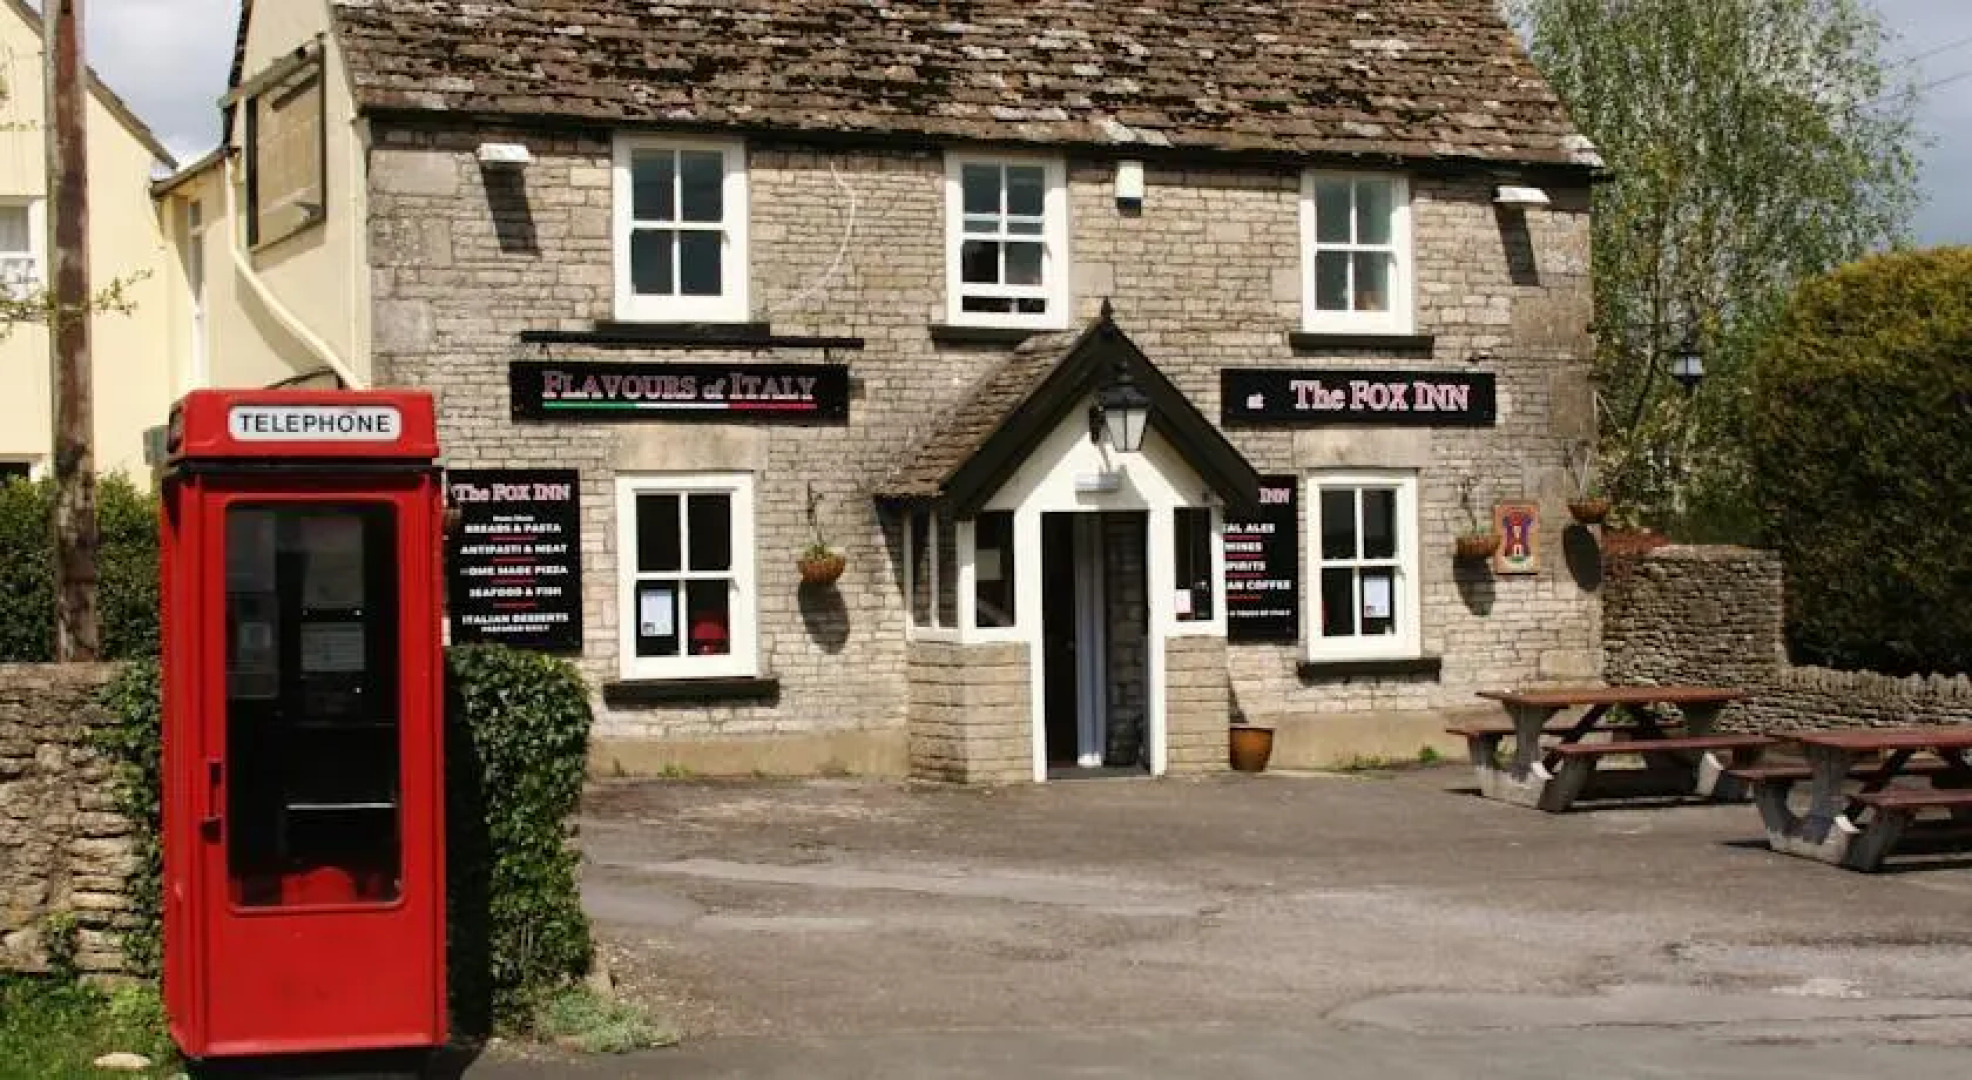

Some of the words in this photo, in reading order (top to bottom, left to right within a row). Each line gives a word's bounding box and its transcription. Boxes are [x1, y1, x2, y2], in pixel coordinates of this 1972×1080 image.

[542, 370, 697, 399] FLAVOURS
[702, 377, 726, 399] of
[729, 372, 817, 400] ITALY
[1290, 380, 1345, 410] The
[1349, 380, 1409, 411] FOX
[1412, 380, 1471, 411] INN
[239, 414, 391, 433] TELEPHONE
[450, 483, 490, 502] The
[492, 483, 531, 501] FOX
[532, 483, 571, 501] INN
[465, 523, 511, 533] BREADS
[513, 523, 522, 533] &
[523, 523, 561, 533] PASTA
[1244, 523, 1276, 534] ALES
[460, 544, 521, 554] ANTIPASTI
[523, 544, 533, 554] &
[535, 543, 568, 554] MEAT
[498, 566, 532, 575] MADE
[534, 565, 568, 575] PIZZA
[1246, 579, 1291, 590] COFFEE
[469, 587, 521, 597] SEAFOOD
[524, 587, 533, 596] &
[535, 586, 562, 596] FISH
[462, 614, 509, 625] ITALIAN
[511, 613, 568, 623] DESSERTS
